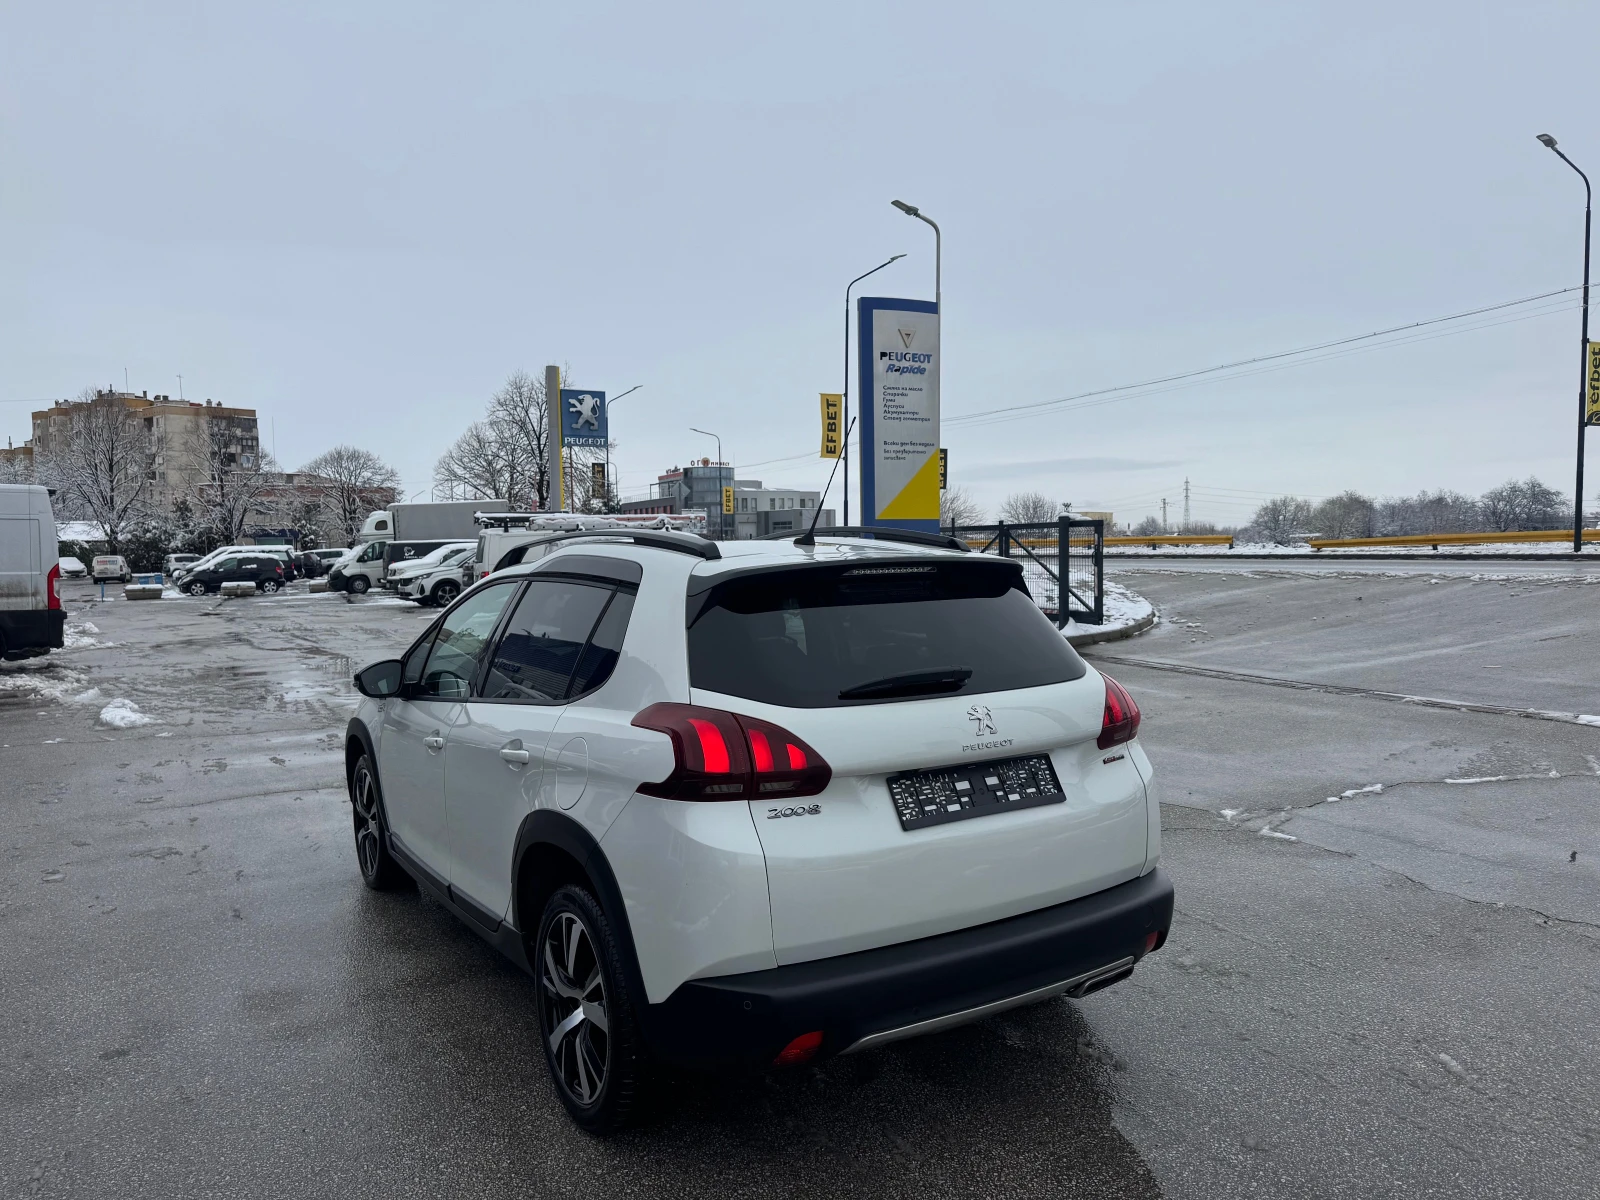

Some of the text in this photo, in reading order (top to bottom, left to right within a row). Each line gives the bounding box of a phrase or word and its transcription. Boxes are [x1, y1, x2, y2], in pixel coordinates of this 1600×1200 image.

[880, 352, 932, 363] PEUGEOT
[886, 364, 926, 375] Rapide
[1590, 347, 1600, 404] efbet
[826, 398, 837, 454] EFBET
[564, 437, 606, 445] PEUGEOT
[962, 739, 1014, 752] PEUGEOT
[767, 803, 822, 819] 2008
